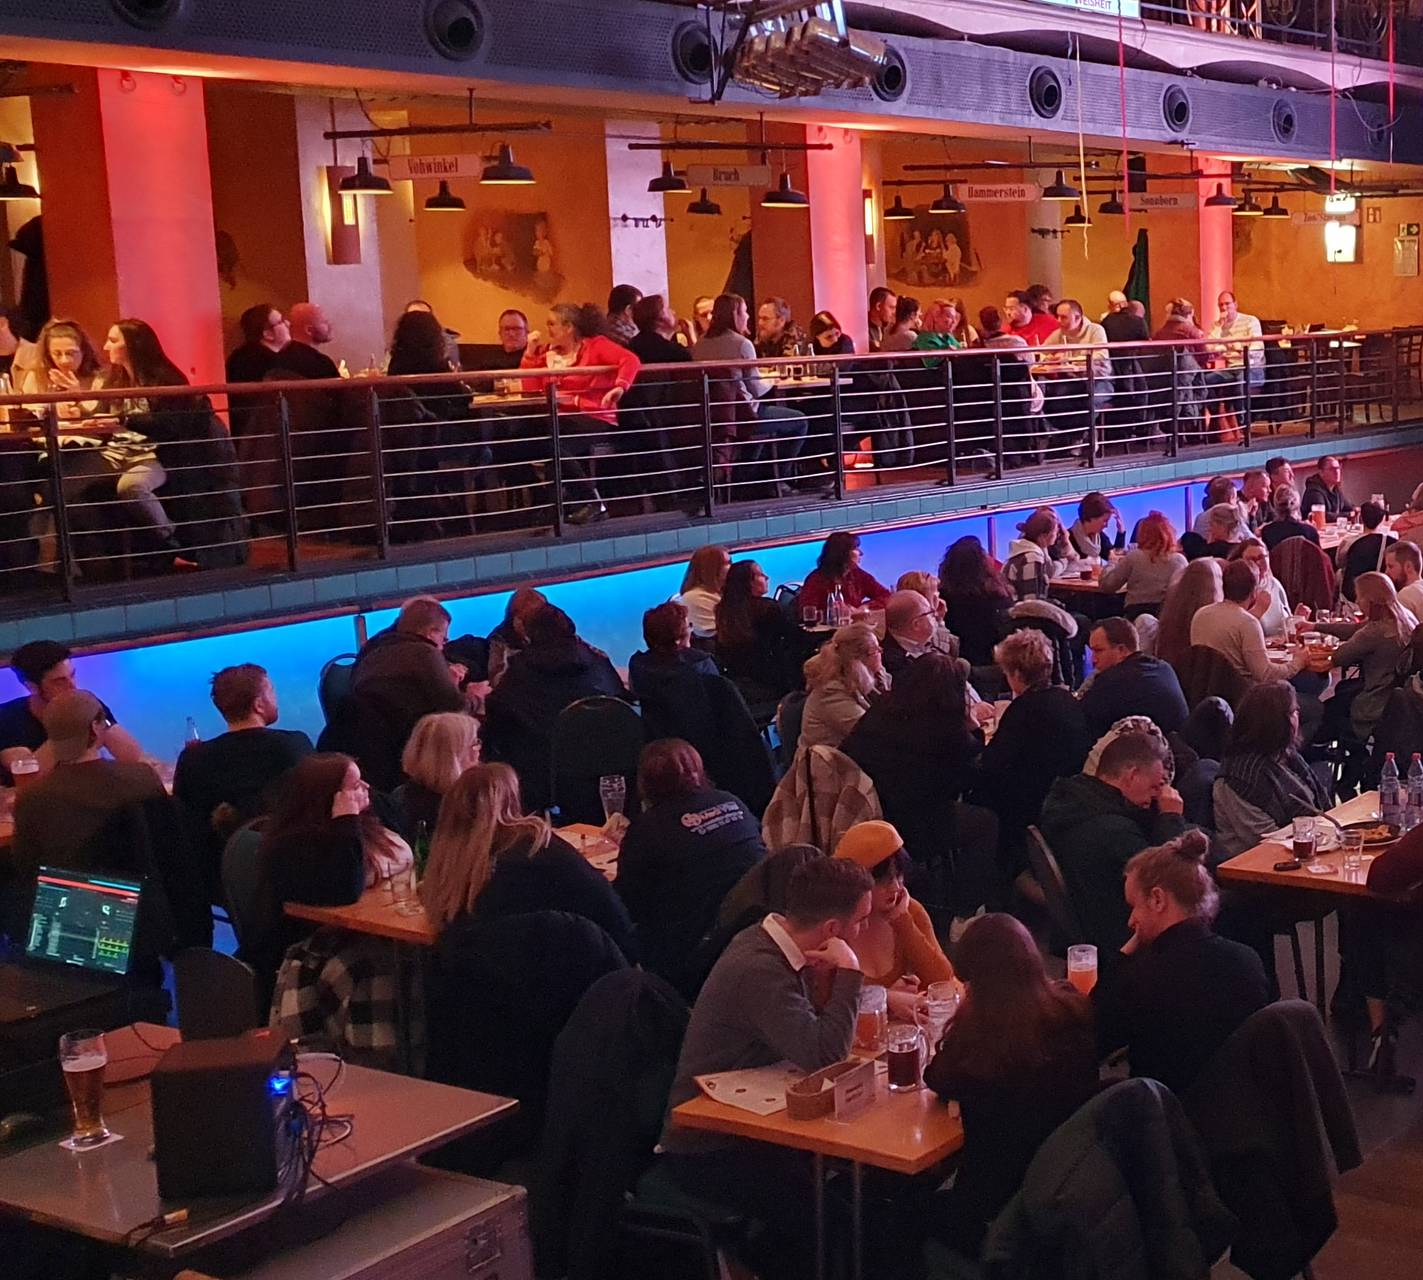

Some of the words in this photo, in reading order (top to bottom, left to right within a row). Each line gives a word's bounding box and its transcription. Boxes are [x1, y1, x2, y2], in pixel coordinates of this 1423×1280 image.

[408, 157, 459, 174] Vohwinkel
[712, 168, 740, 181] Bruch
[968, 186, 1026, 198] Hammerstein
